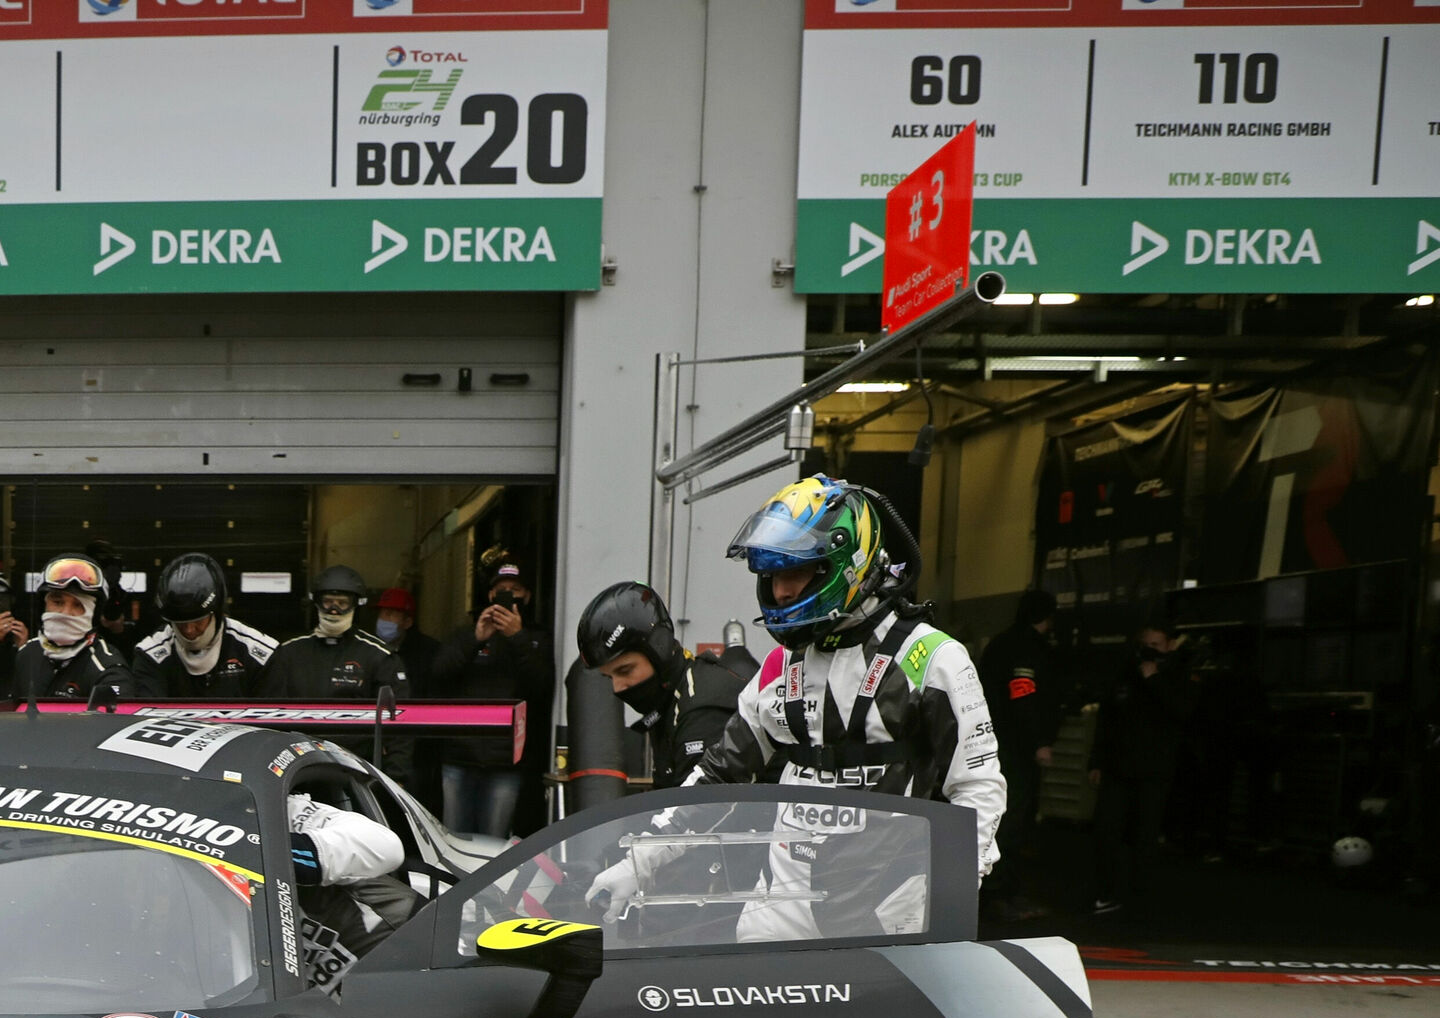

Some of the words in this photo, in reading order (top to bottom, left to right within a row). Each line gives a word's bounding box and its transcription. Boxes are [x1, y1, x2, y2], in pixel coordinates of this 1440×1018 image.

[410, 50, 468, 63] TOTAL
[910, 54, 982, 105] 60
[1193, 52, 1279, 105] 110
[358, 112, 441, 127] nürburgring
[891, 125, 928, 138] ALEX
[933, 124, 996, 138] AUTMN
[1135, 123, 1222, 138] TEICHMANN
[1227, 123, 1283, 138] RACING
[1287, 122, 1331, 137] GMBH
[460, 93, 589, 185] 20
[356, 142, 457, 187] BOX
[993, 173, 1023, 187] CUP
[1168, 172, 1202, 187] KTM
[1204, 172, 1259, 187] X-BOW
[1263, 172, 1292, 186] GT4
[150, 227, 282, 265] DEKRA
[423, 226, 557, 264] DEKRA
[969, 229, 1038, 266] KRA
[1184, 228, 1323, 265] DEKRA
[789, 666, 800, 699] SIMPSON
[864, 657, 886, 694] SIMPSON
[8, 811, 97, 830] DRIVING
[101, 822, 227, 860] SIMULATOR
[276, 878, 299, 977] SIEGERDESIGNS
